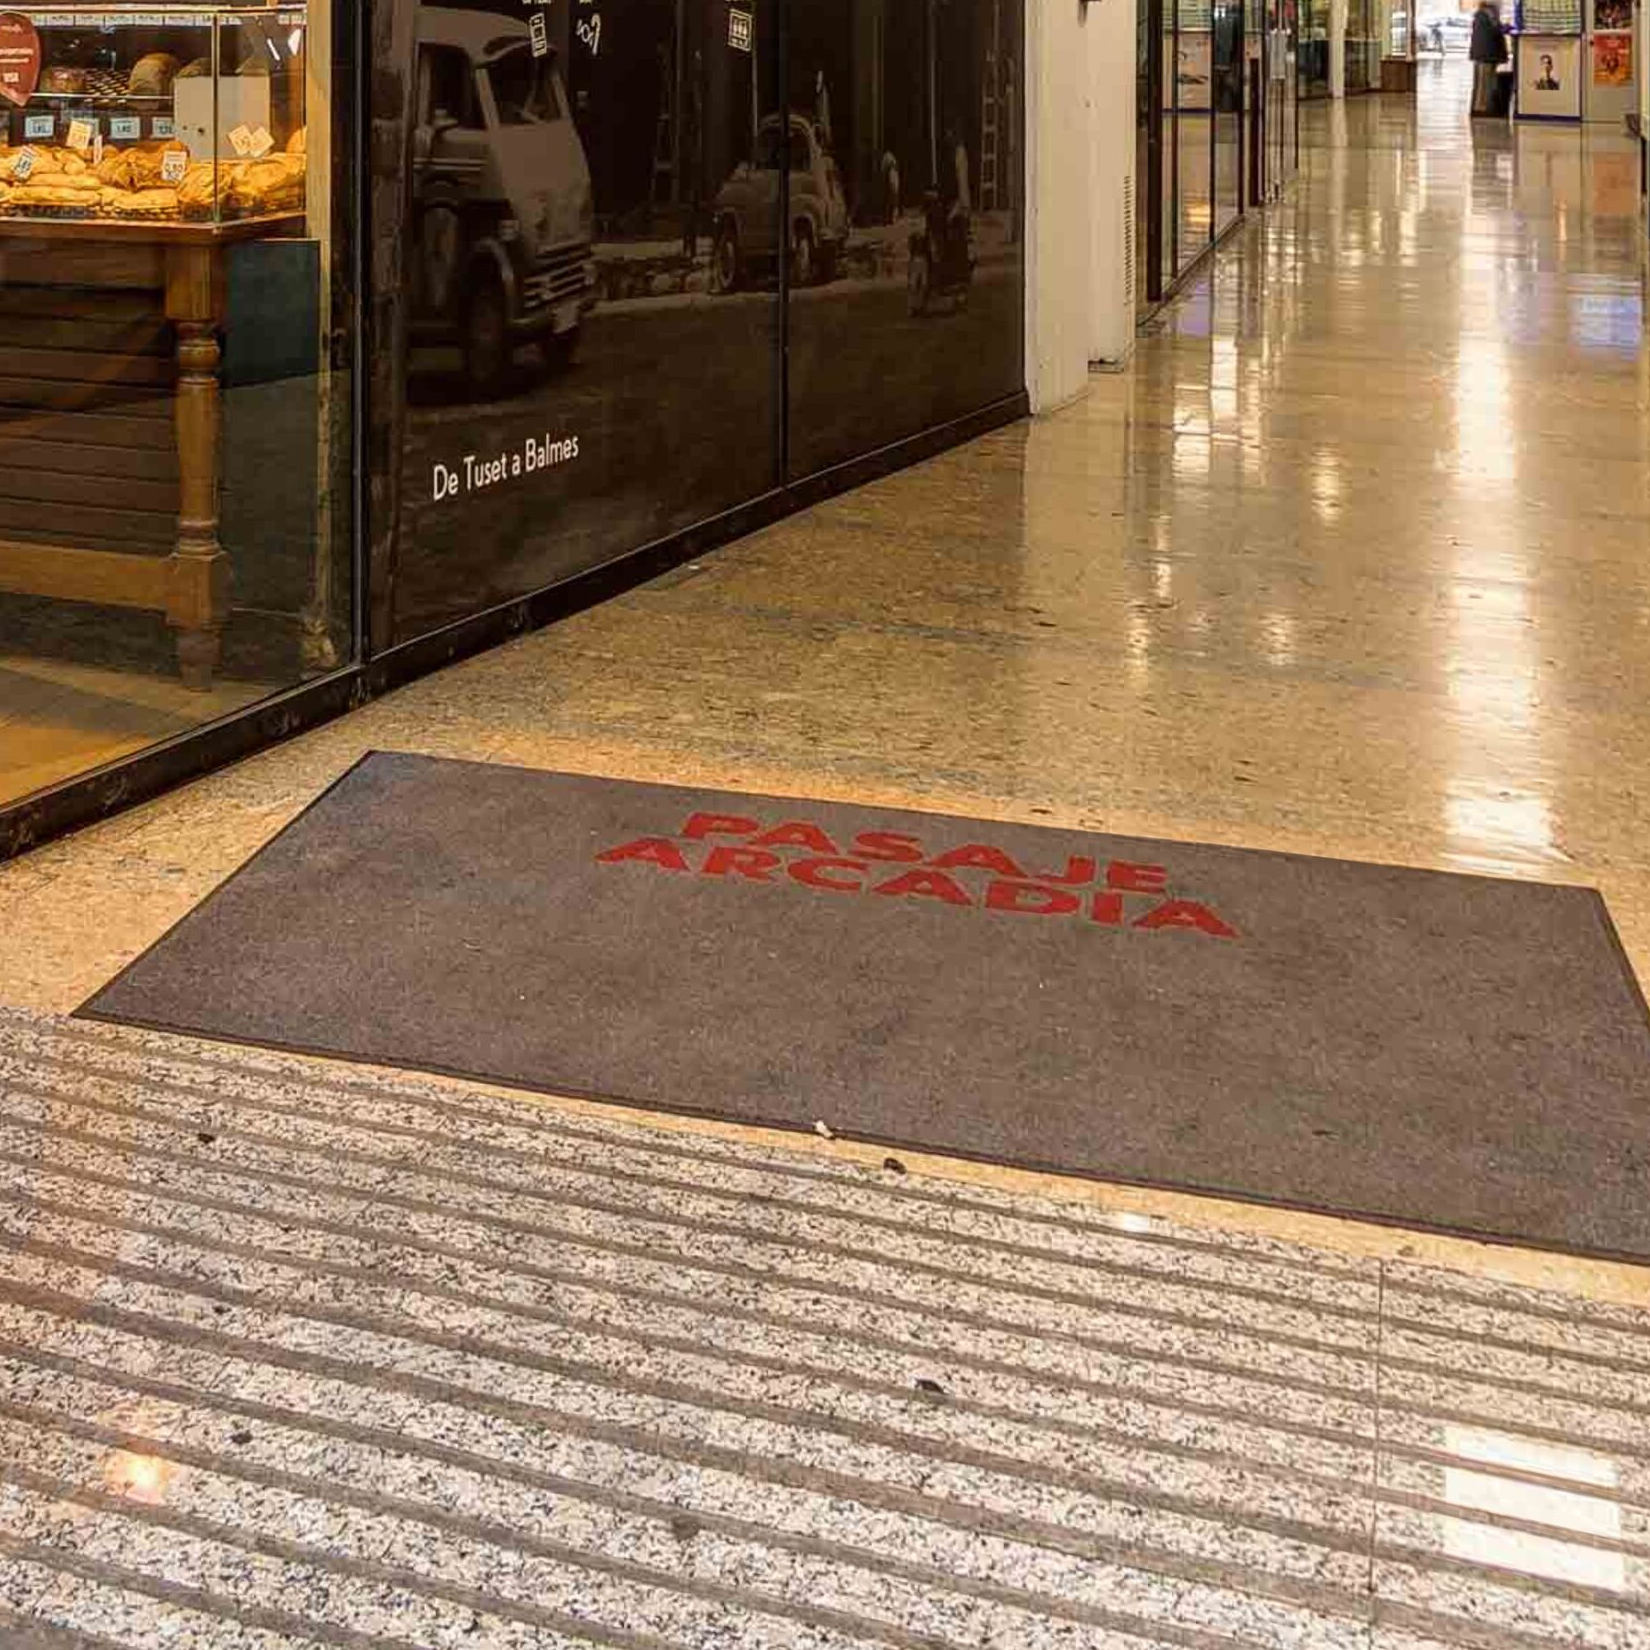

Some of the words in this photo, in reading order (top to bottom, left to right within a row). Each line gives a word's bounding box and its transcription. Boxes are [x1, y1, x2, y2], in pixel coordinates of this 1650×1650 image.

[434, 464, 459, 501] De
[463, 455, 508, 491] Tuset
[511, 454, 521, 476] a
[525, 433, 580, 473] Balmes
[596, 837, 1239, 938] ARCADIA
[679, 811, 1174, 895] PASAJE
